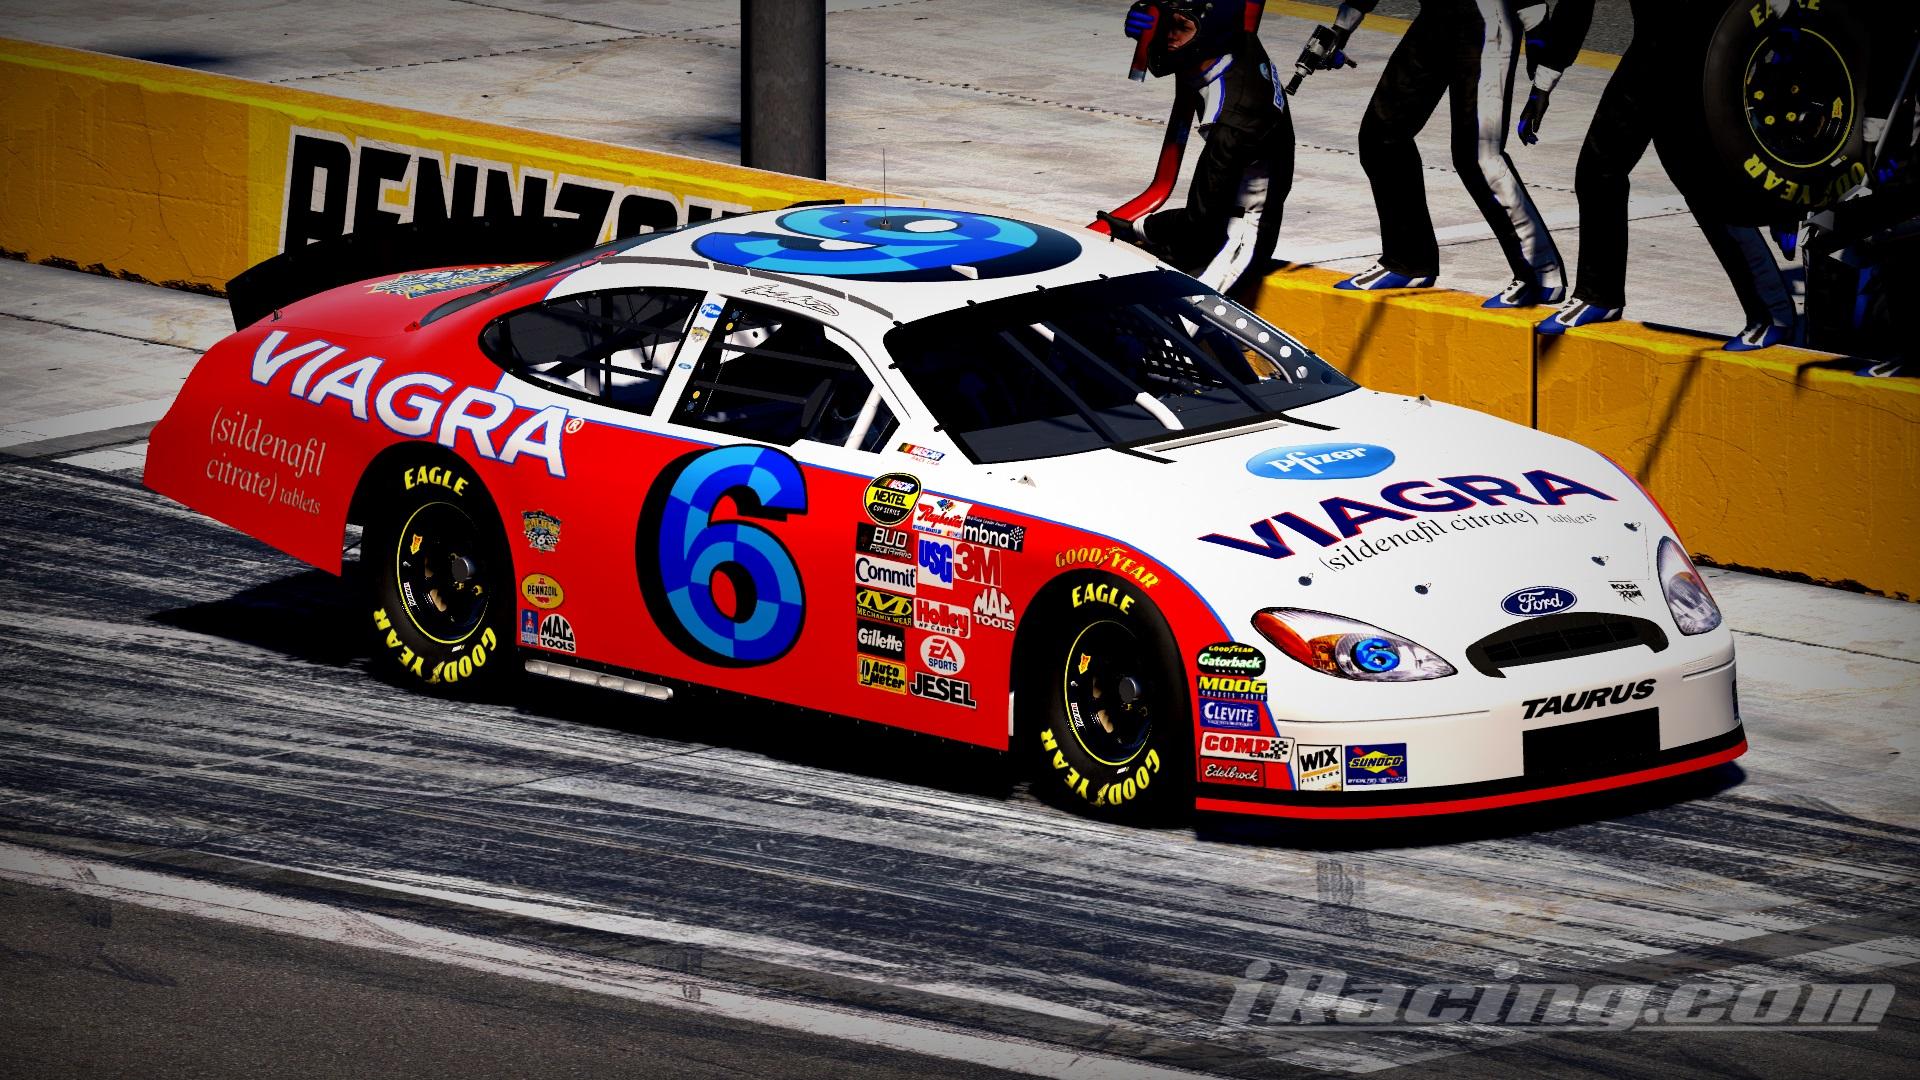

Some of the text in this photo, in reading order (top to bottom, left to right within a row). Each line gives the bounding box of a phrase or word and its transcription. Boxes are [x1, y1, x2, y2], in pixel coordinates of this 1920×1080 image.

[210, 406, 326, 478] (sildenafil
[206, 452, 321, 515] citrate) tablets
[404, 465, 469, 496] EAGLE
[873, 489, 906, 507] NEXTEL
[1197, 469, 1618, 559] VIAGRA
[872, 527, 908, 548] BUD
[963, 523, 1009, 549] mbna
[1319, 521, 1444, 573] (sildenafil
[1449, 508, 1539, 535] citrate)
[635, 443, 809, 669] 6
[919, 539, 953, 583] USG
[954, 542, 1001, 587] 3M
[856, 557, 916, 588] Commit
[527, 584, 558, 597] PENNZOIL
[1071, 583, 1135, 616] EAGLE
[1517, 590, 1564, 613] Ford
[857, 606, 891, 621] MECHANIX
[973, 587, 1015, 621] MAC
[541, 615, 575, 642] MAC
[916, 600, 968, 638] Holley
[972, 613, 1015, 631] TOOLS
[541, 637, 575, 652] TOOLS
[858, 628, 903, 652] Gillette
[928, 639, 957, 662] EA
[928, 657, 958, 672] SPORTS
[1198, 652, 1264, 669] Gatorback
[1350, 637, 1400, 673] 6
[872, 662, 900, 677] Auto
[910, 673, 976, 707] JESEL
[1198, 676, 1267, 695] MOOG
[1522, 679, 1656, 719] TAURUS
[1204, 735, 1270, 754] COMP
[1249, 751, 1282, 760] CAMS
[1204, 763, 1259, 782] Edelbrock
[1300, 747, 1339, 773] WIX
[1350, 755, 1403, 768] SUNOCO
[1301, 770, 1340, 784] FILTERS
